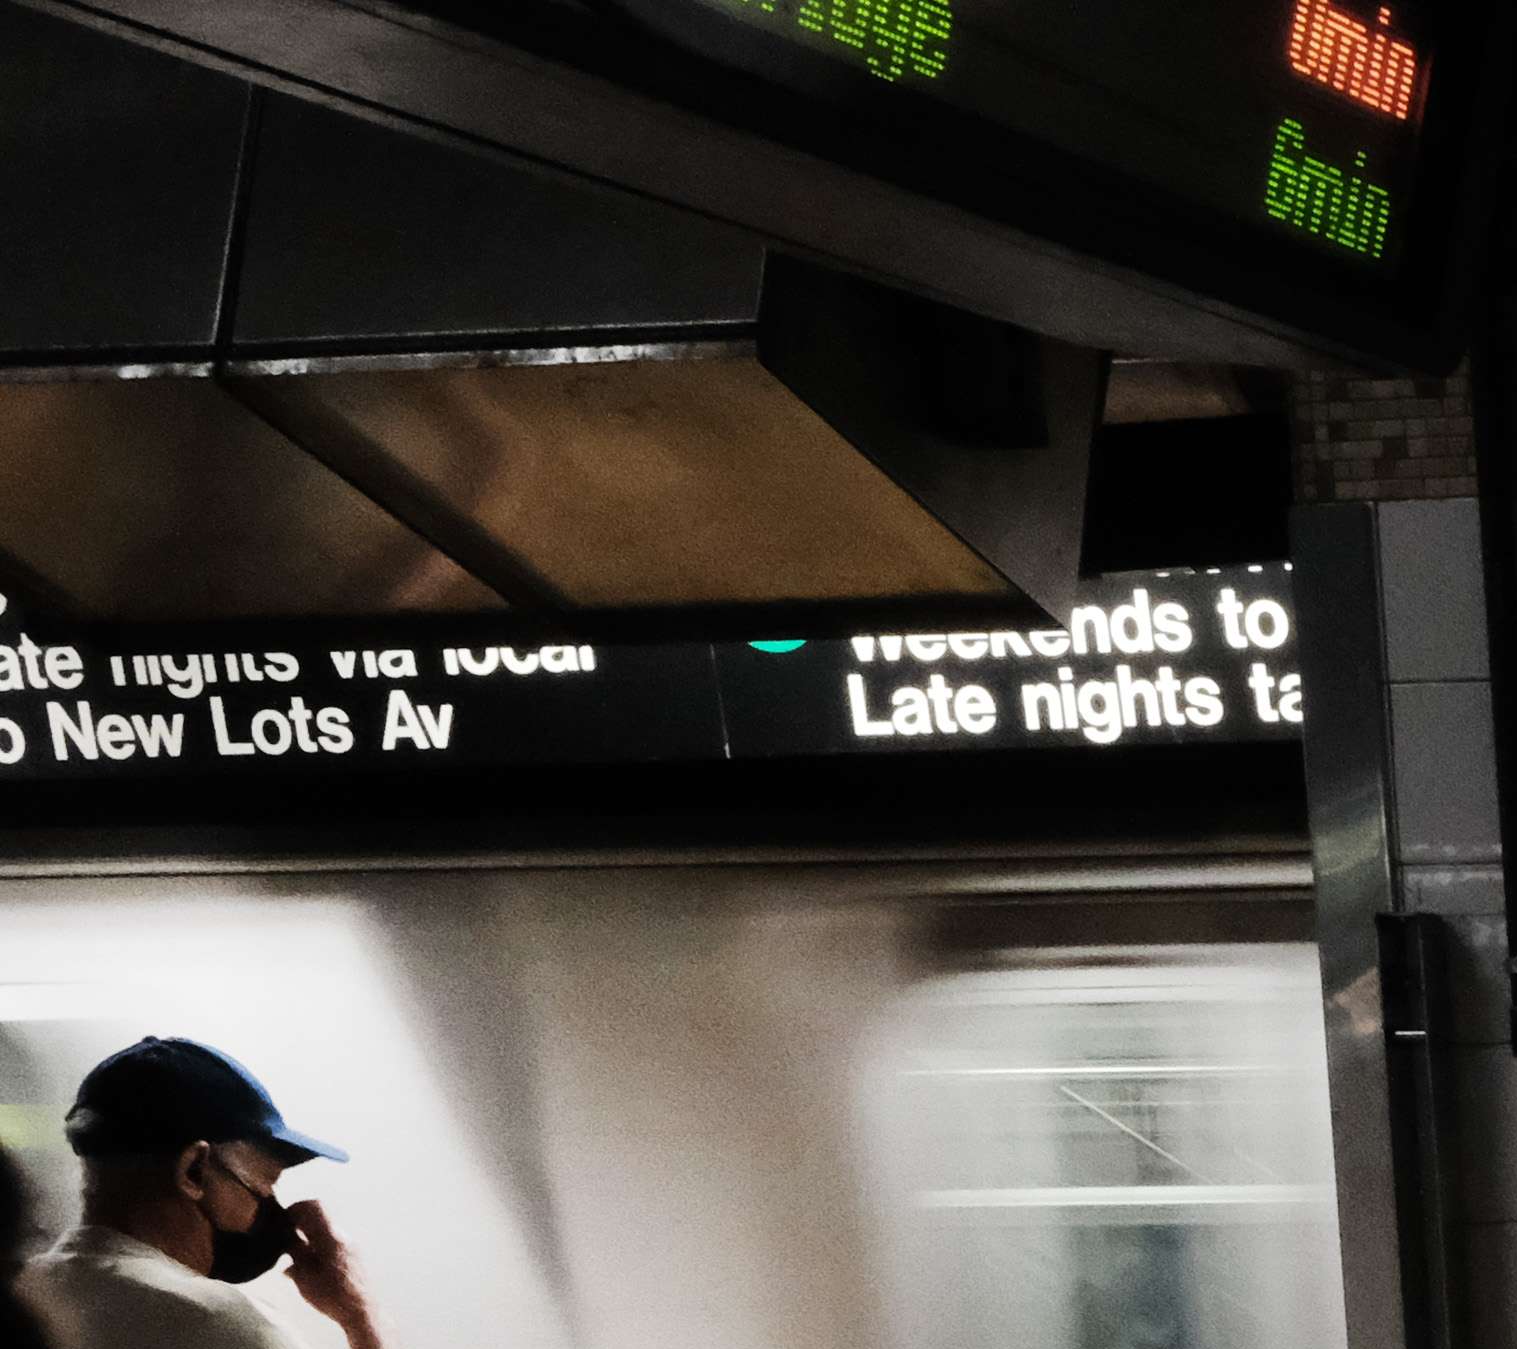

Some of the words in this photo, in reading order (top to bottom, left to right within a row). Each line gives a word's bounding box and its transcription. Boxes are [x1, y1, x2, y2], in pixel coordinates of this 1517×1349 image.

[1264, 117, 1390, 259] 6min
[1217, 588, 1290, 648] to
[0, 633, 83, 691] ate
[0, 716, 26, 764] o
[46, 701, 184, 761] New
[209, 696, 354, 756] Lots
[382, 689, 454, 751] Av
[846, 673, 997, 737] Late
[1020, 664, 1224, 743] nights
[1248, 663, 1304, 722] ta
